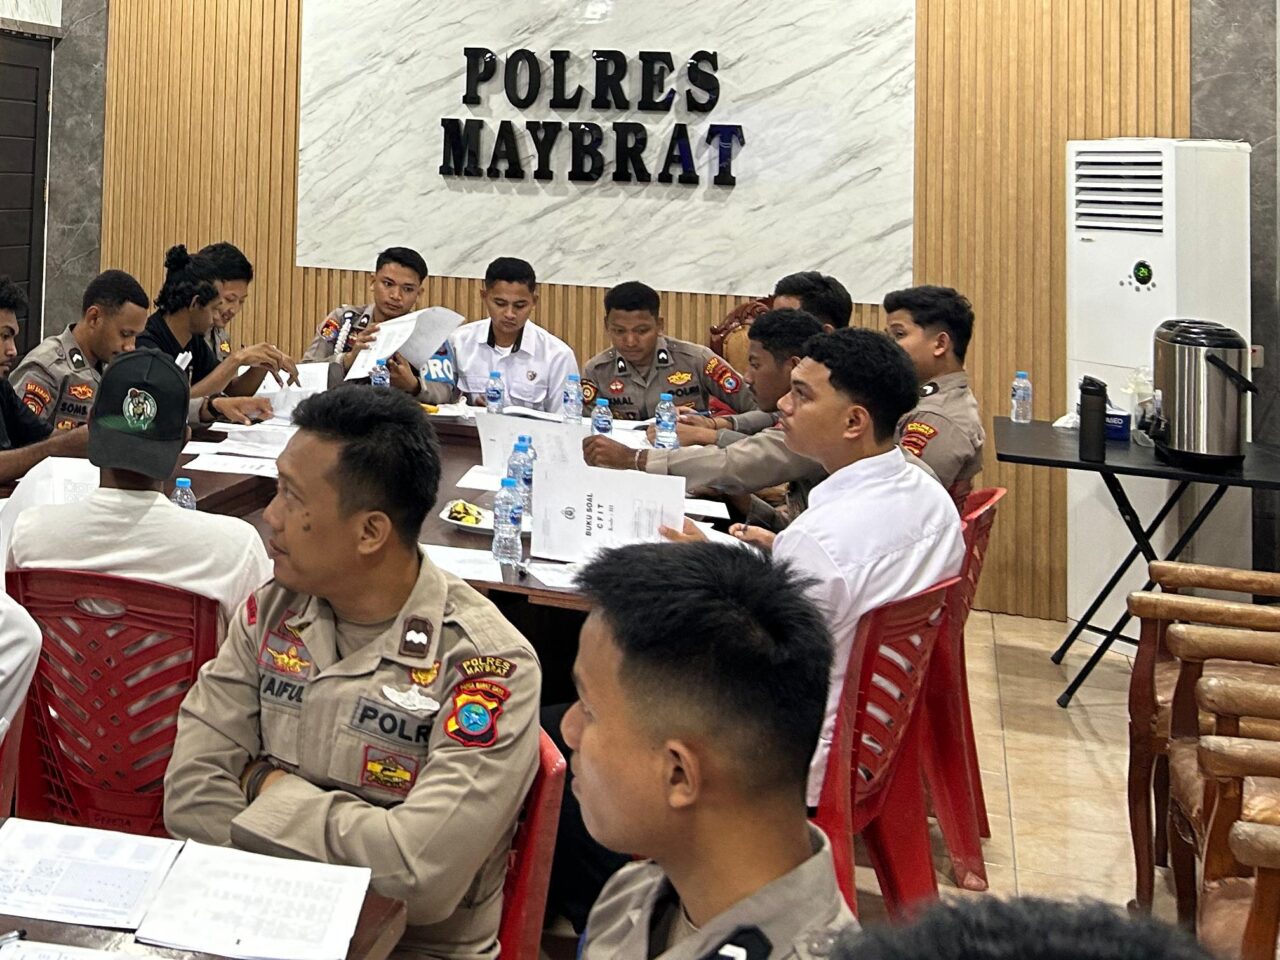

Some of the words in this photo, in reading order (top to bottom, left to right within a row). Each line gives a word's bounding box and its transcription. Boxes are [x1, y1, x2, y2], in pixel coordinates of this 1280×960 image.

[462, 46, 720, 112] POLRES
[439, 118, 745, 185] MAYBRAT
[585, 514, 593, 536] BUKU
[462, 657, 510, 671] POLRES
